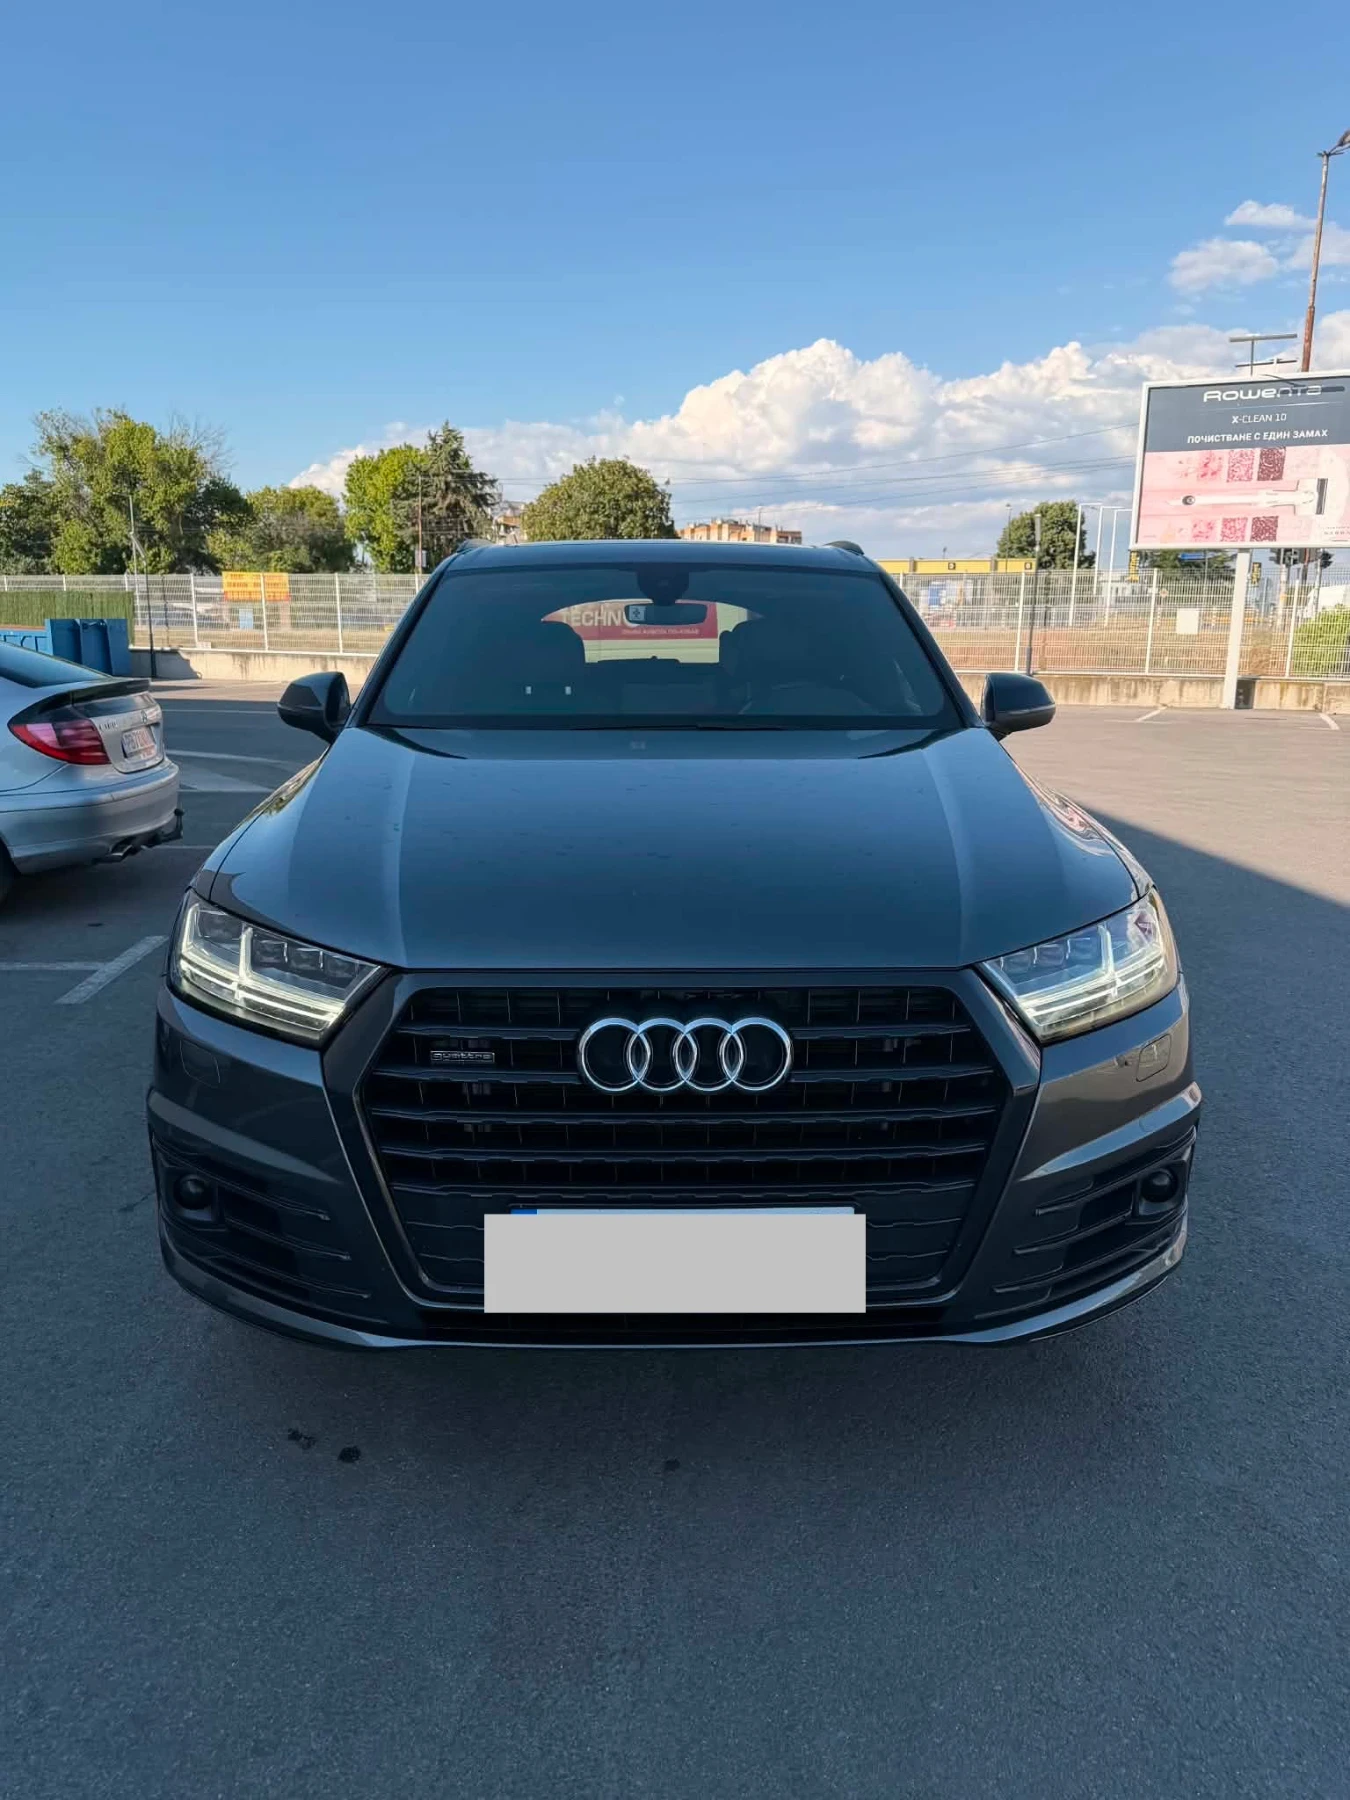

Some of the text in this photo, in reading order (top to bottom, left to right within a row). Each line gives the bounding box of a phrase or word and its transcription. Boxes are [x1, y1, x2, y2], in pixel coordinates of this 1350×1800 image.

[1231, 413, 1287, 424] X-CLEAN 10
[1187, 429, 1329, 444] ПОЧИСТВАНЕ С ЕДИН ЗАМАХ
